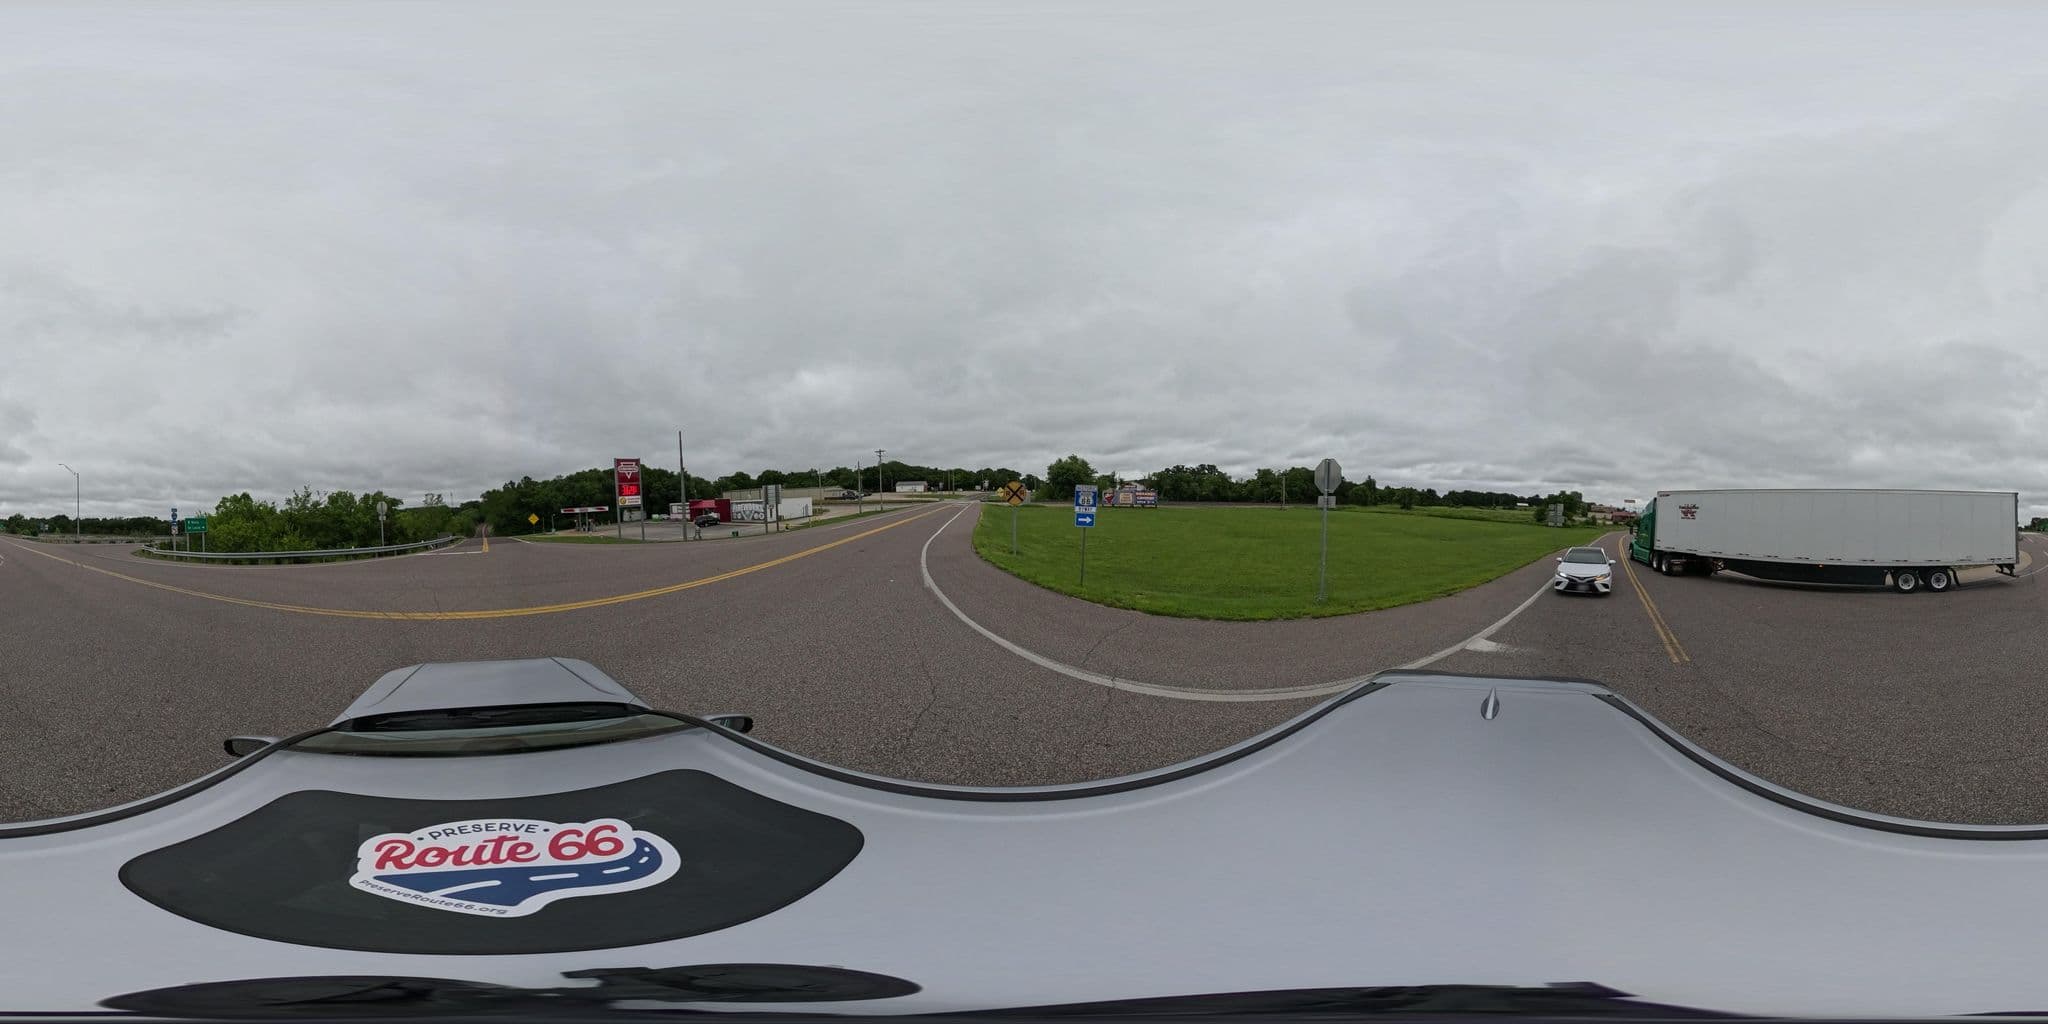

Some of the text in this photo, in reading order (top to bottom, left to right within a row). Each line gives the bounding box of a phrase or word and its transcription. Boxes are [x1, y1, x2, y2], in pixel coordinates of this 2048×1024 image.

[374, 824, 624, 870] Route 66
[428, 822, 539, 840] PRESERVE
[358, 879, 509, 915] PreserveRoute66.org
